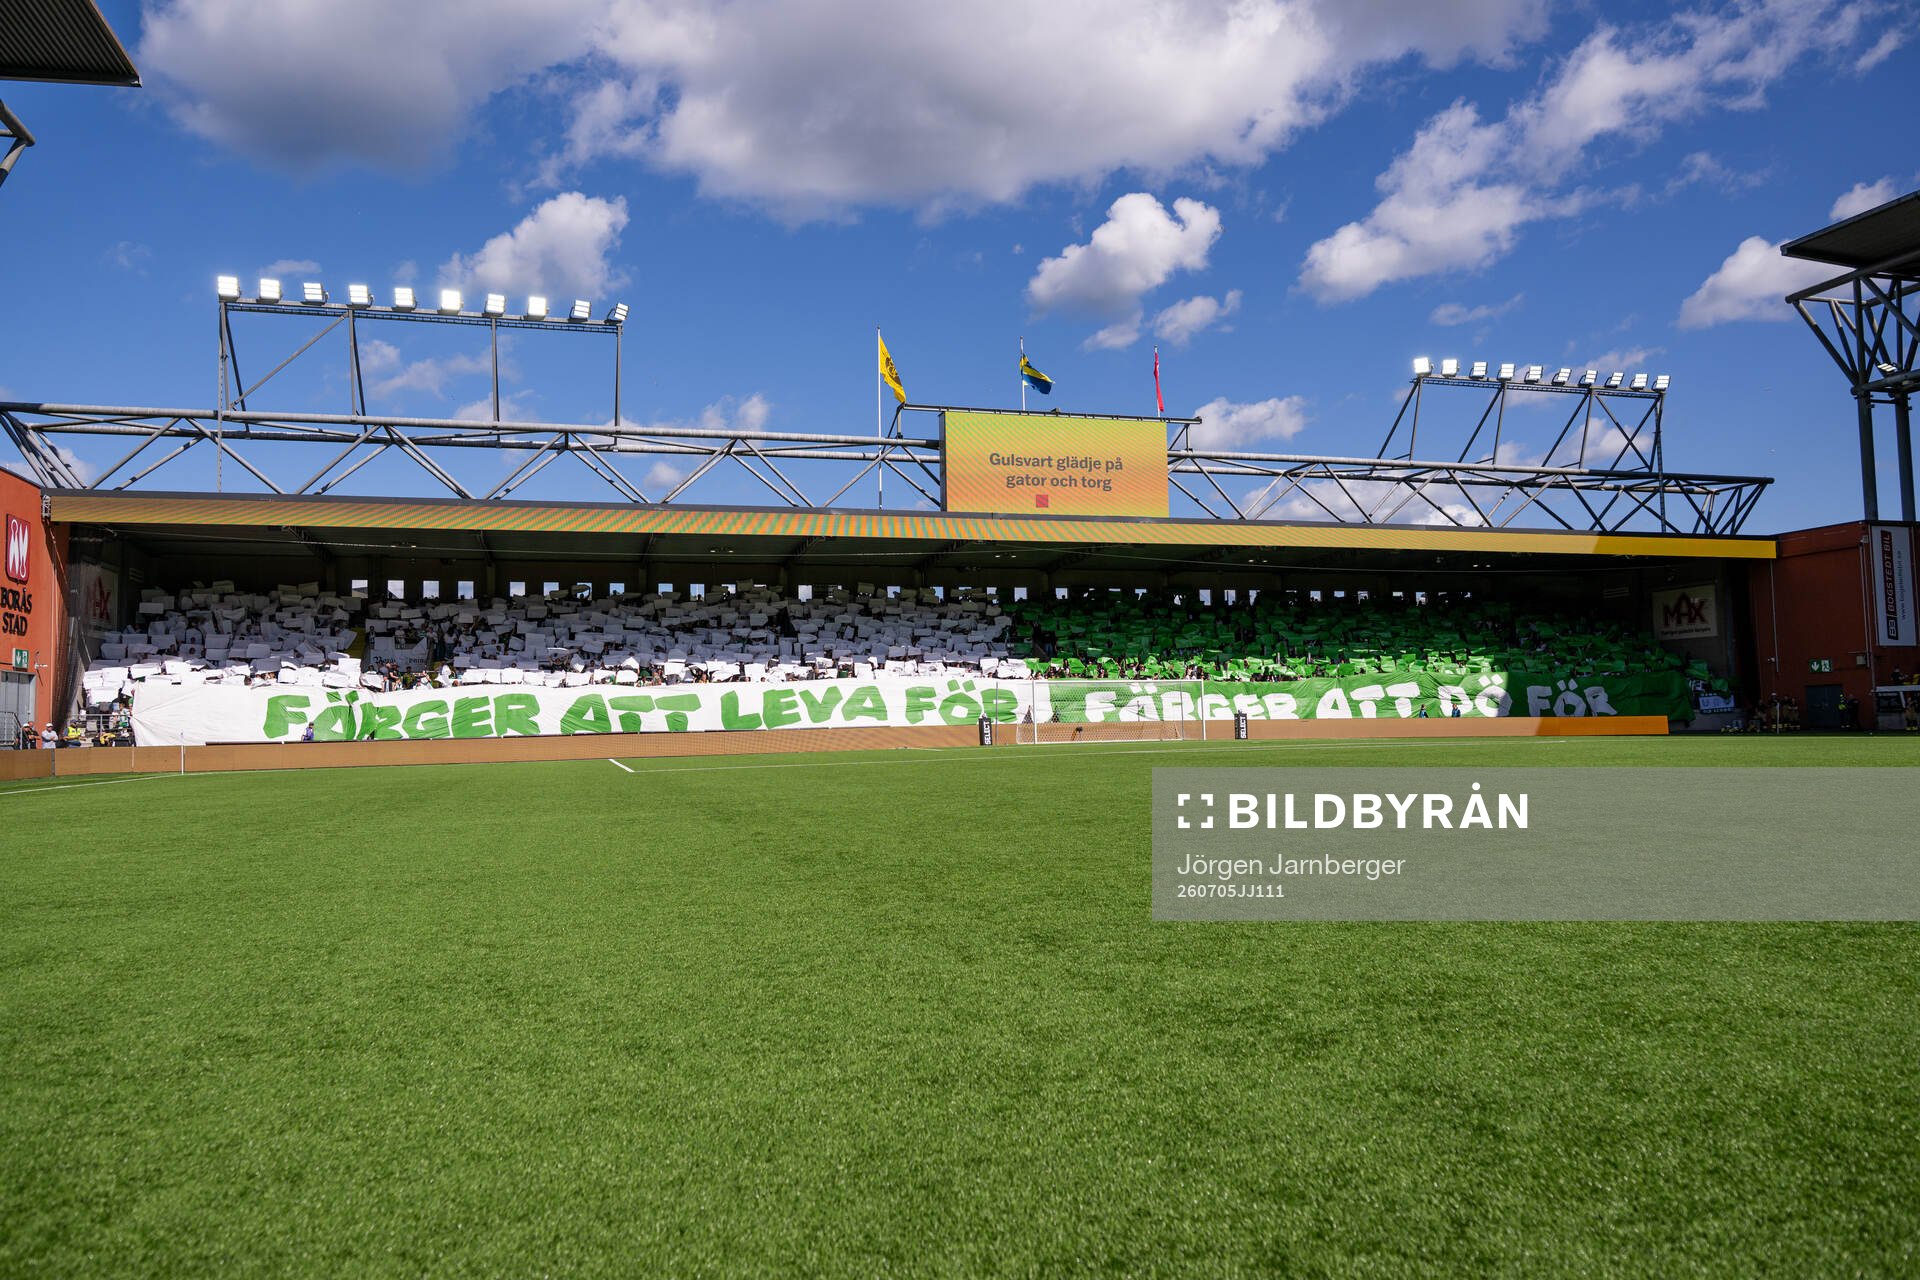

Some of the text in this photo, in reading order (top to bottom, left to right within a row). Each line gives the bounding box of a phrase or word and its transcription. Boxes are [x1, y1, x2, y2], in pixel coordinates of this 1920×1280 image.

[989, 453, 1123, 472] Gulsvart glädje på
[1006, 474, 1112, 491] gator och torg
[1883, 535, 1891, 552] BIL
[1884, 553, 1895, 612] BOGSTEDT
[0, 587, 32, 614] BORÅS
[2, 612, 28, 636] STAD
[263, 679, 1019, 741] FÄRGER ATT LEVA FÖR
[1085, 673, 1618, 722] FÄRGER ATT DÖ FÖR
